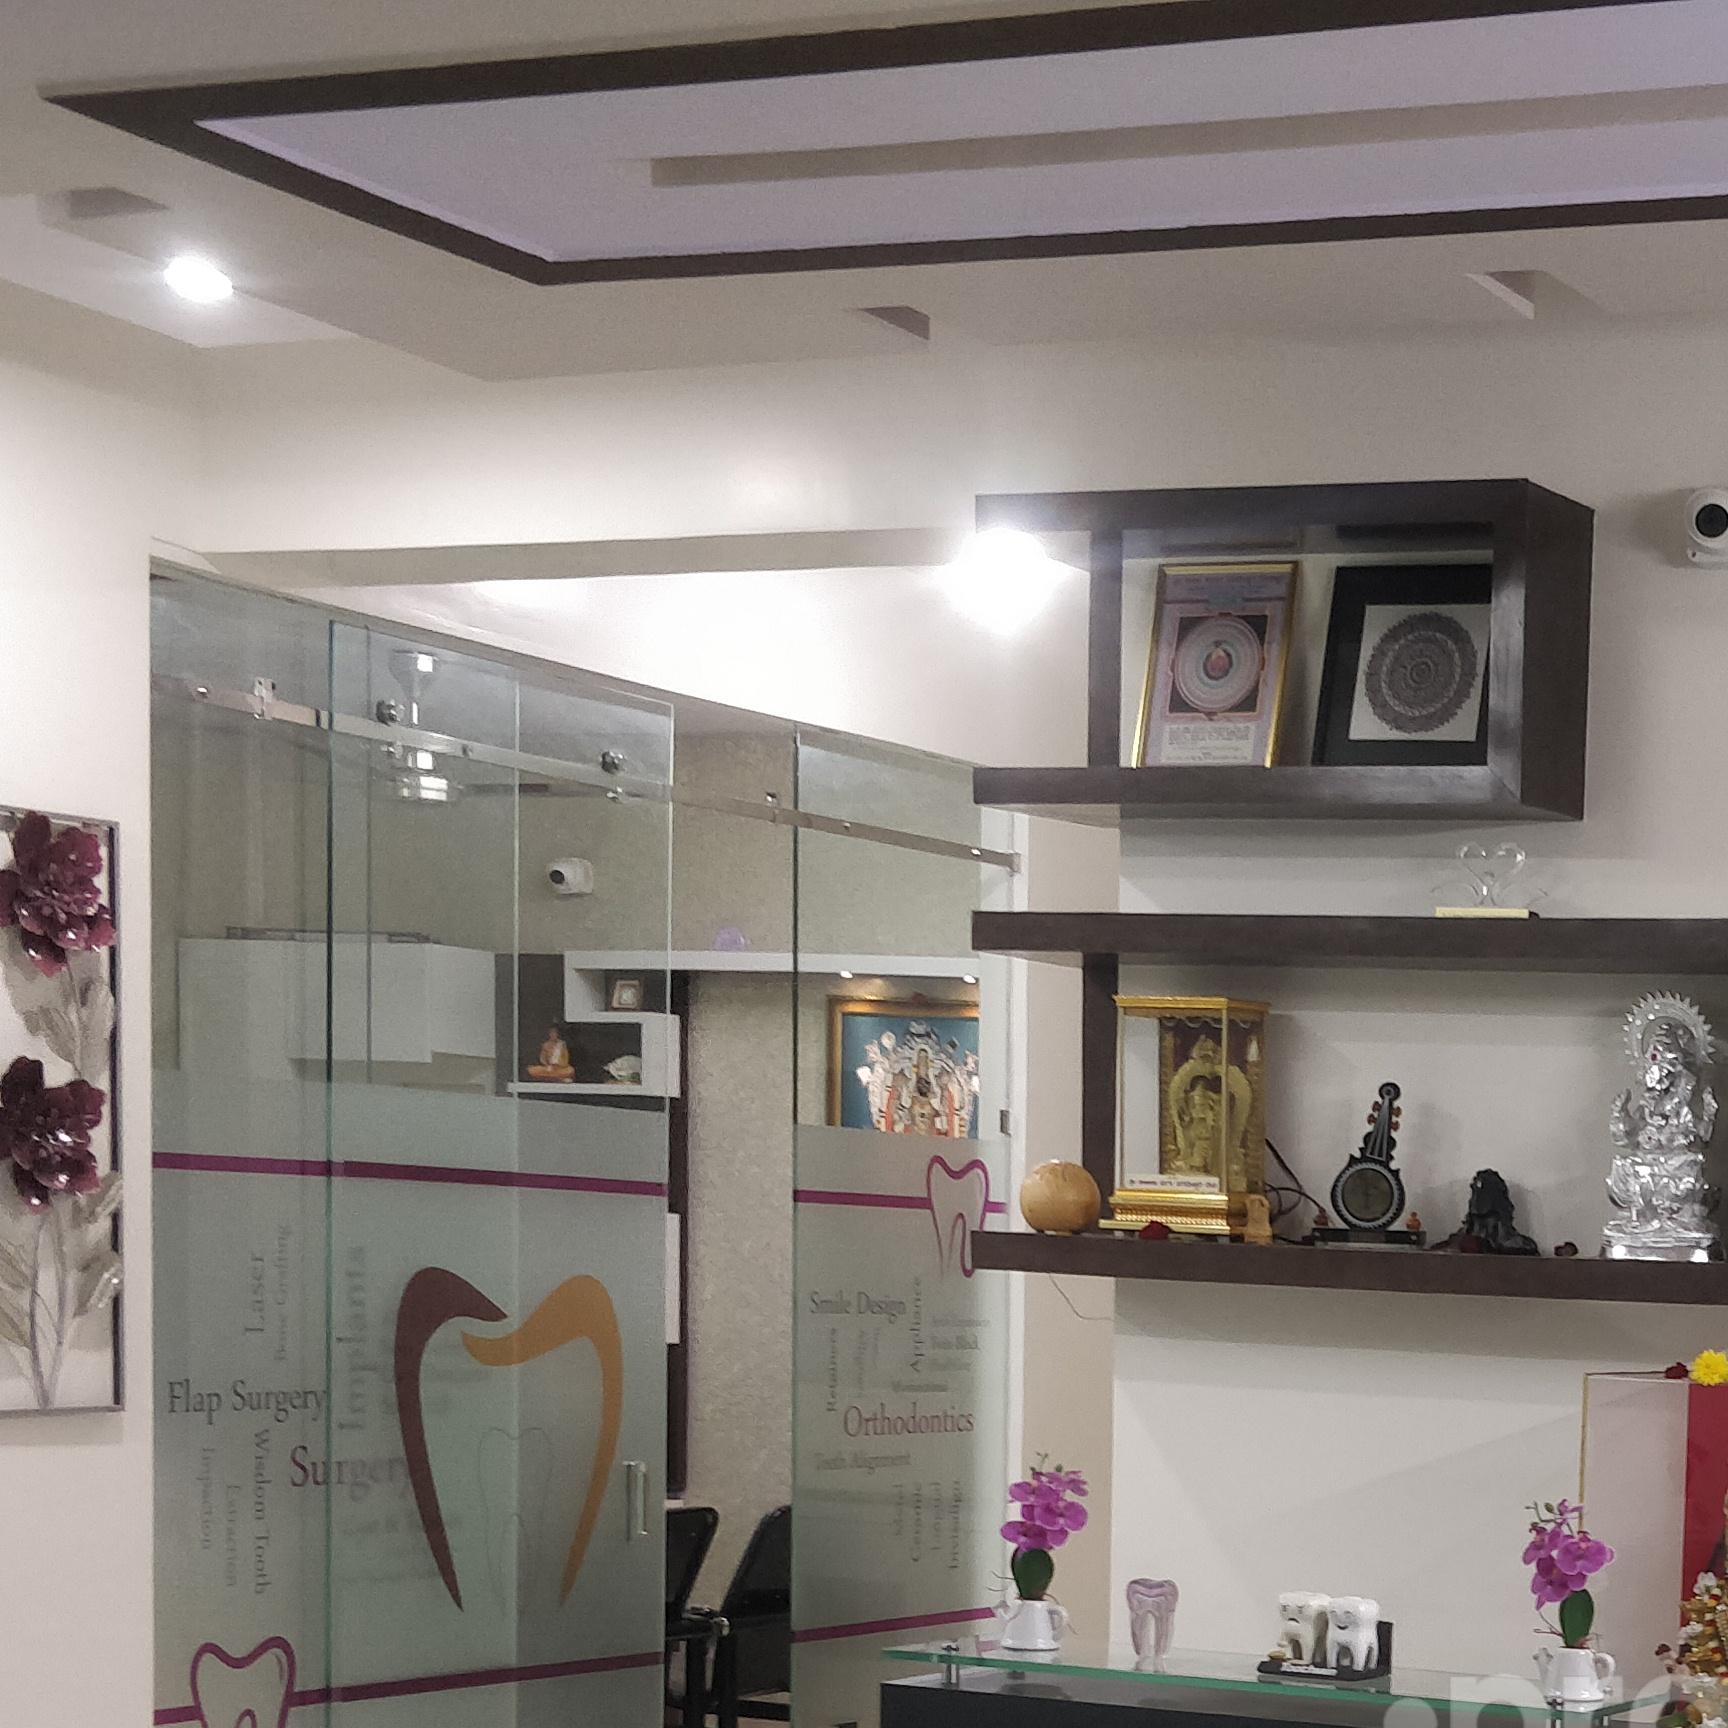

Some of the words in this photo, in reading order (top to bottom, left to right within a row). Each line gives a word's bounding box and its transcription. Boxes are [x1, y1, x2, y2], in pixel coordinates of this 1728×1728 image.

[243, 1251, 265, 1336] Laser
[809, 1289, 851, 1315] Smile
[857, 1290, 906, 1325] Design
[168, 1378, 222, 1425] Flap
[231, 1379, 328, 1423] Surgery
[843, 1403, 975, 1438] Orthodontics
[254, 1429, 272, 1521] Wisdom
[254, 1527, 273, 1595] Tooth
